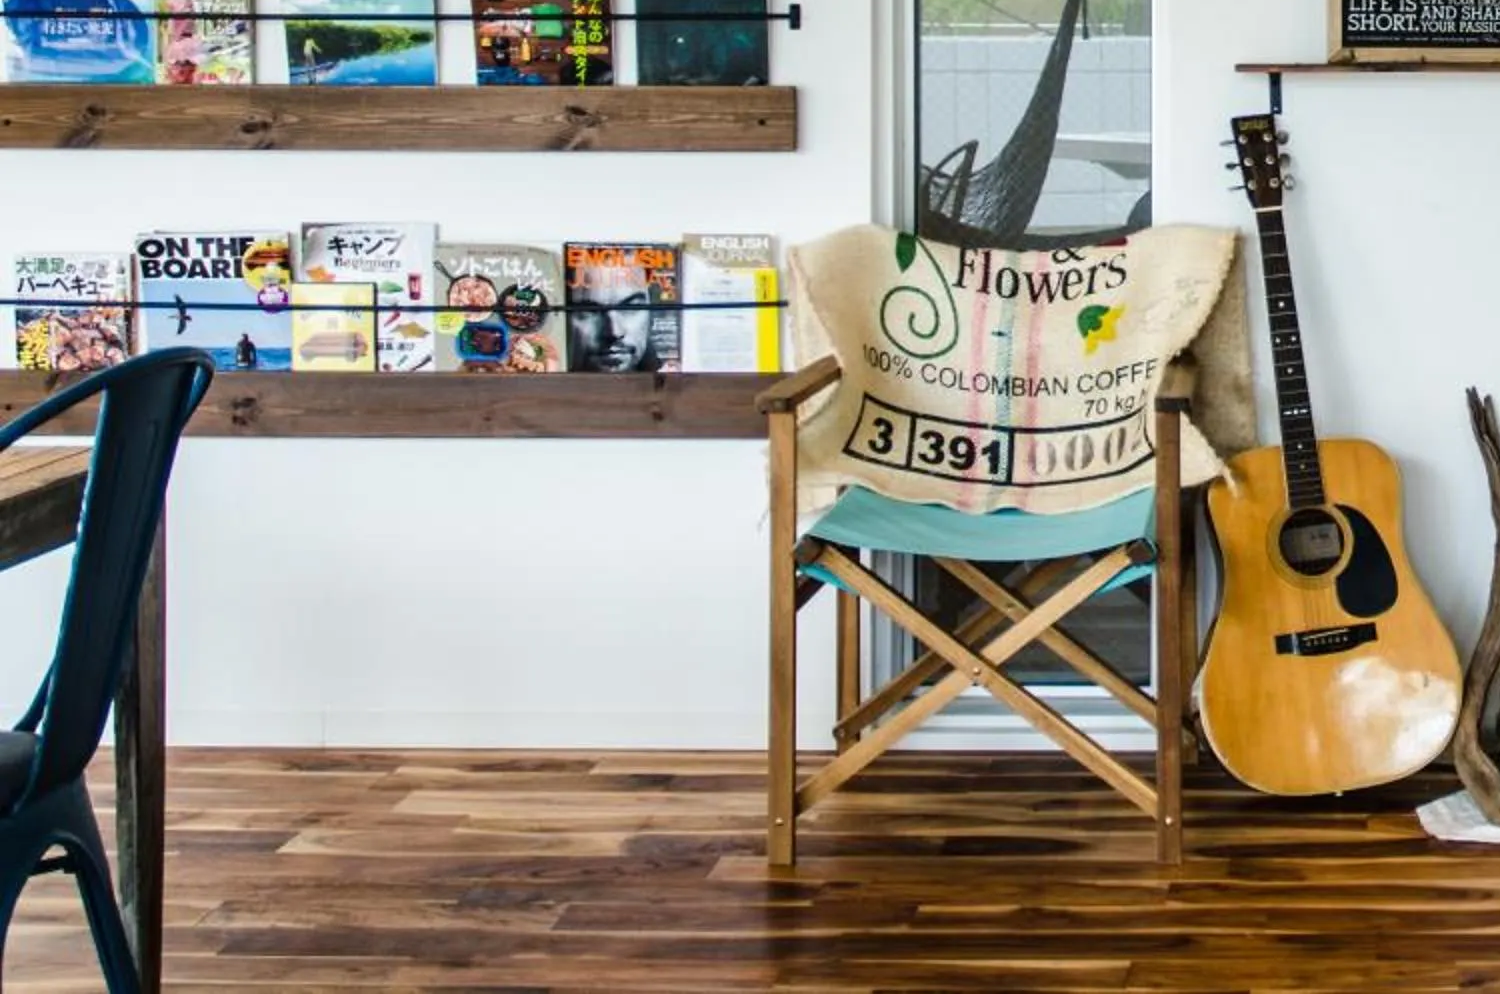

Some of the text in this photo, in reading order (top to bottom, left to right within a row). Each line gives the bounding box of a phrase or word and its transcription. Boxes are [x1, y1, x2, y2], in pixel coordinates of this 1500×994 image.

[1347, 13, 1420, 31] SHORT.
[1420, 6, 1457, 20] AND
[1420, 21, 1456, 33] YOUR
[138, 237, 191, 258] ON
[17, 275, 114, 296] バーベキュー
[952, 248, 1128, 304] Flowers
[863, 344, 913, 379] 100%
[920, 363, 1069, 397] COLOMBIAN
[1084, 397, 1109, 418] 70
[1114, 395, 1136, 413] kg
[867, 417, 894, 455] 3
[918, 429, 1001, 475] 391
